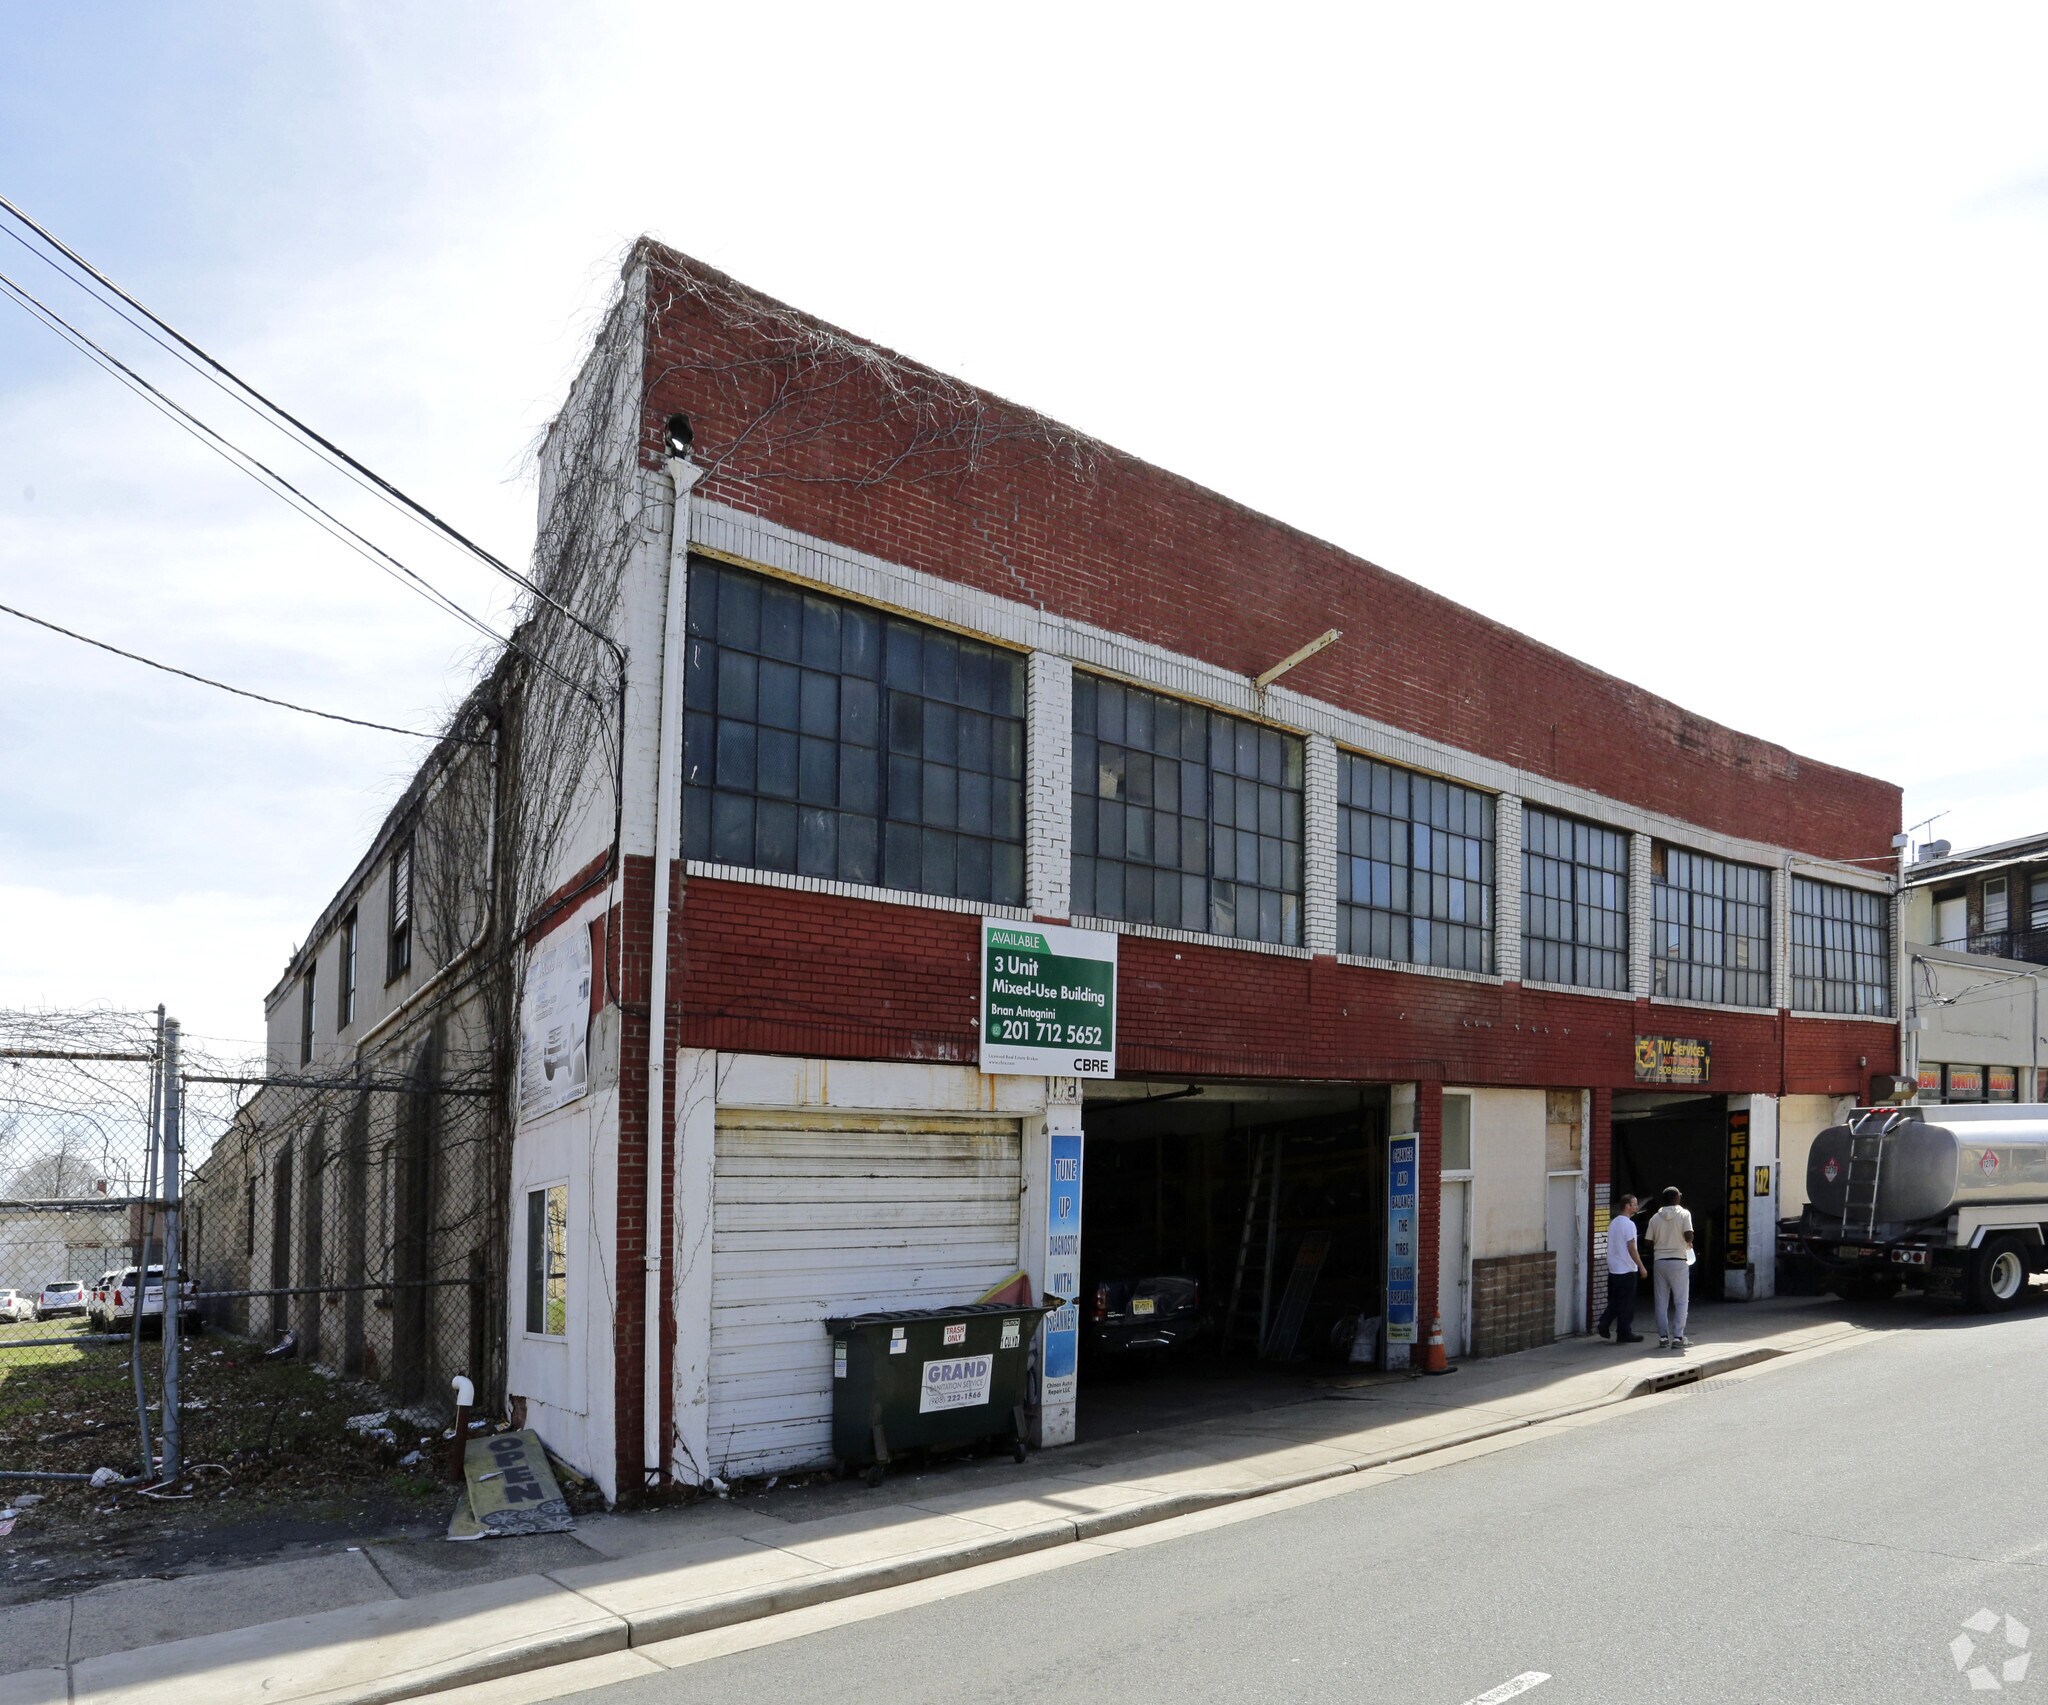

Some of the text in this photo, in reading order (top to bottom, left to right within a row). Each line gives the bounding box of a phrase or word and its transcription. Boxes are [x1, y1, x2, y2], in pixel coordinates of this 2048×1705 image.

[991, 931, 1040, 949] AVAILABLE
[994, 955, 1039, 976] 3 Unit
[992, 978, 1105, 1007] Mixed-Use Building
[1016, 1005, 1056, 1021] Antognini
[1002, 1020, 1102, 1045] 201 712 5652
[1657, 1039, 1705, 1057] TW Services
[1073, 1058, 1109, 1073] CBRE
[1663, 1056, 1677, 1065] AUTO
[1393, 1147, 1414, 1163] CHANGE
[1055, 1159, 1077, 1181] TUNE
[1397, 1171, 1408, 1187] AND
[1728, 1131, 1746, 1244] ENTRANCE
[1059, 1197, 1071, 1218] UP
[1391, 1194, 1414, 1210] BALANCE
[1398, 1219, 1408, 1233] THE
[1049, 1234, 1078, 1256] DIAGNOSTIC
[1395, 1243, 1409, 1256] TIRES
[1053, 1272, 1072, 1294] WITH
[1048, 1309, 1075, 1332] SCANNER
[946, 1325, 965, 1335] TRASH
[947, 1333, 962, 1343] ONLY
[928, 1360, 987, 1383] GRAND
[963, 1379, 983, 1389] SERVICE
[488, 1437, 545, 1504] OPEN
